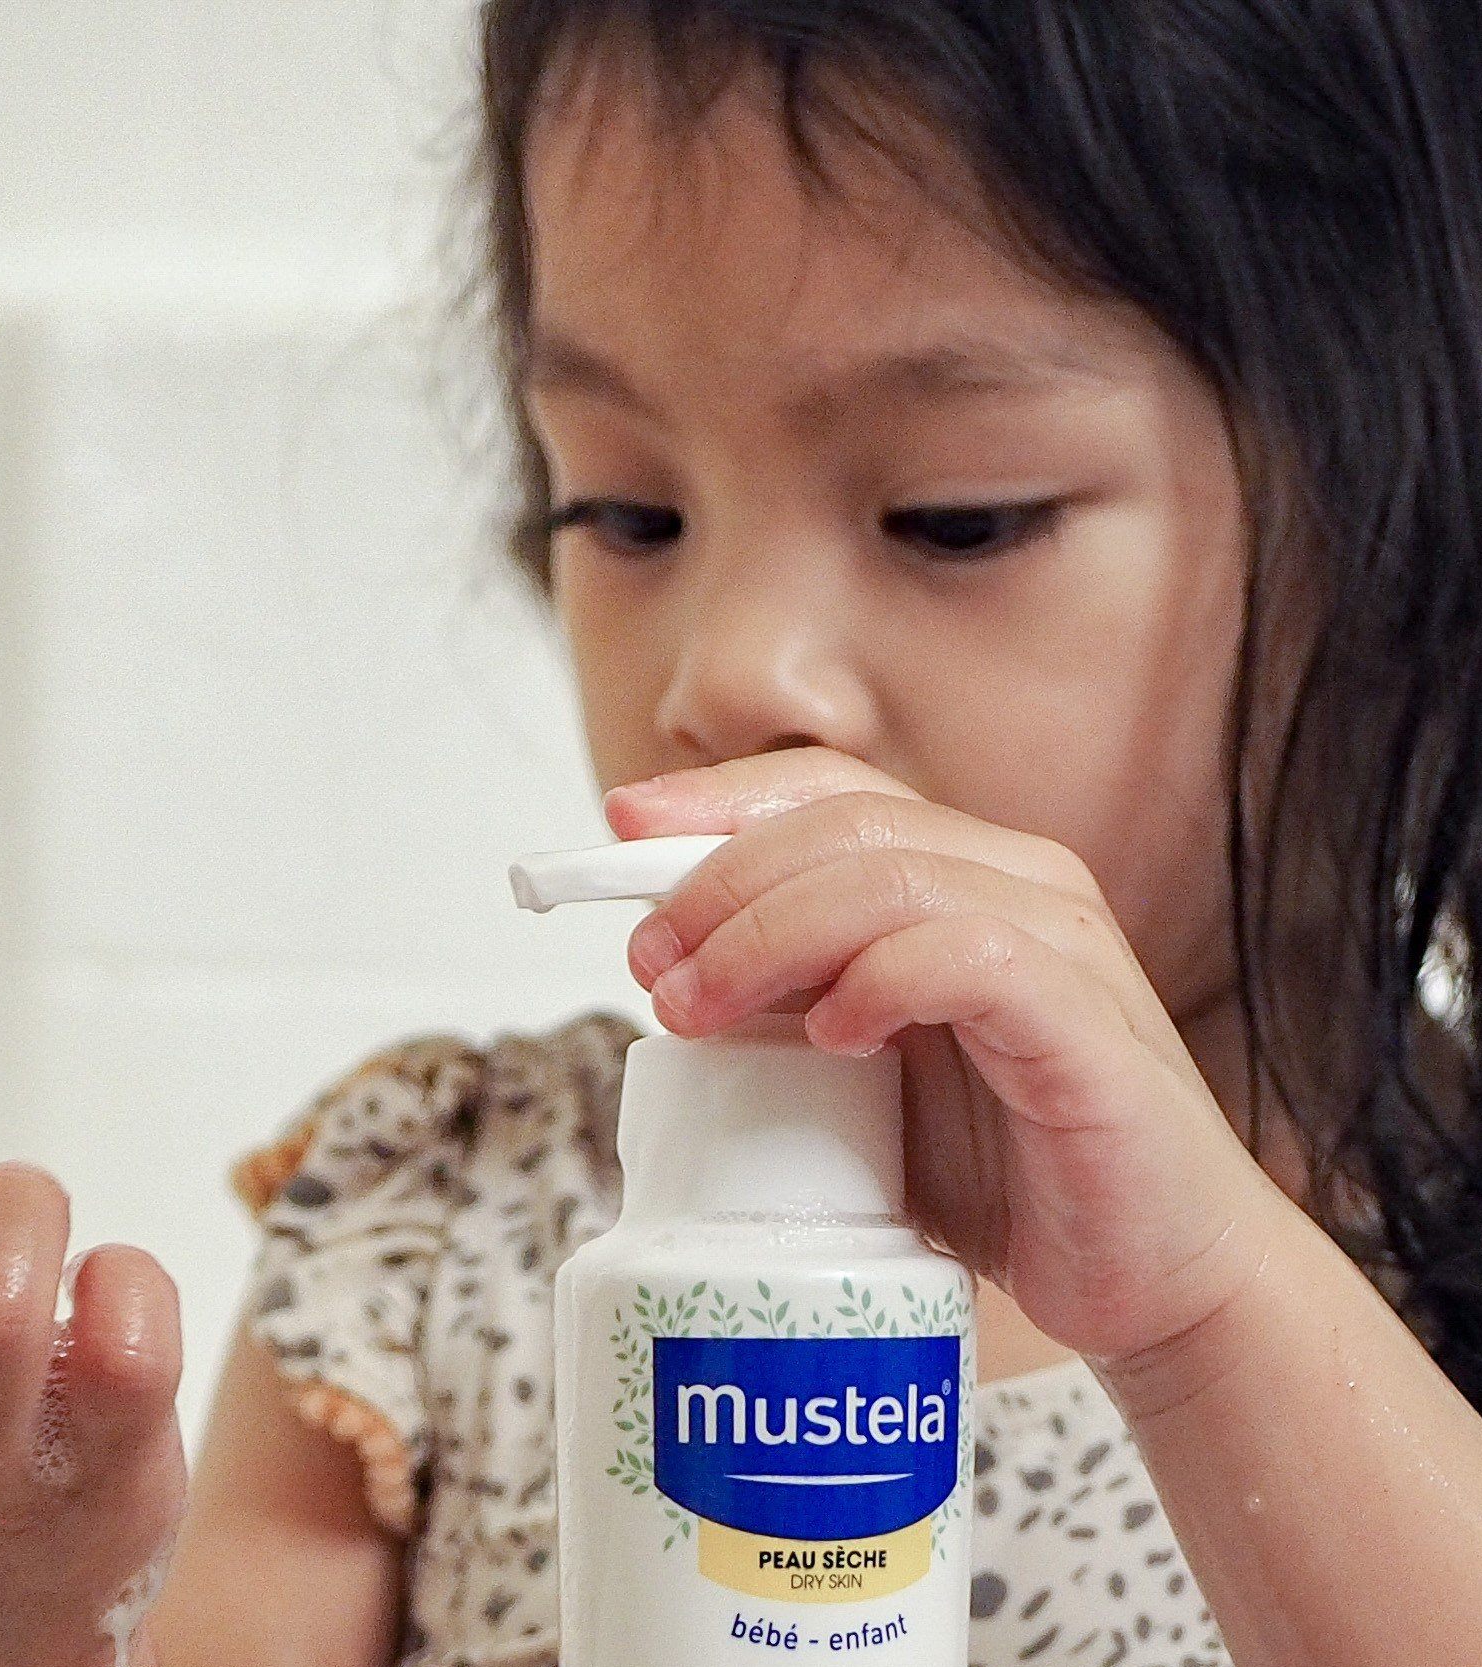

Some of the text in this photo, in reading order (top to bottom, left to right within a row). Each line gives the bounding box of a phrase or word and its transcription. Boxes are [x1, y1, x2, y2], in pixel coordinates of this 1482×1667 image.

[759, 1546, 887, 1569] PEAU SÈCHE
[790, 1573, 863, 1589] DRY SKIN
[731, 1613, 798, 1649] bébé
[829, 1613, 907, 1651] enfant
